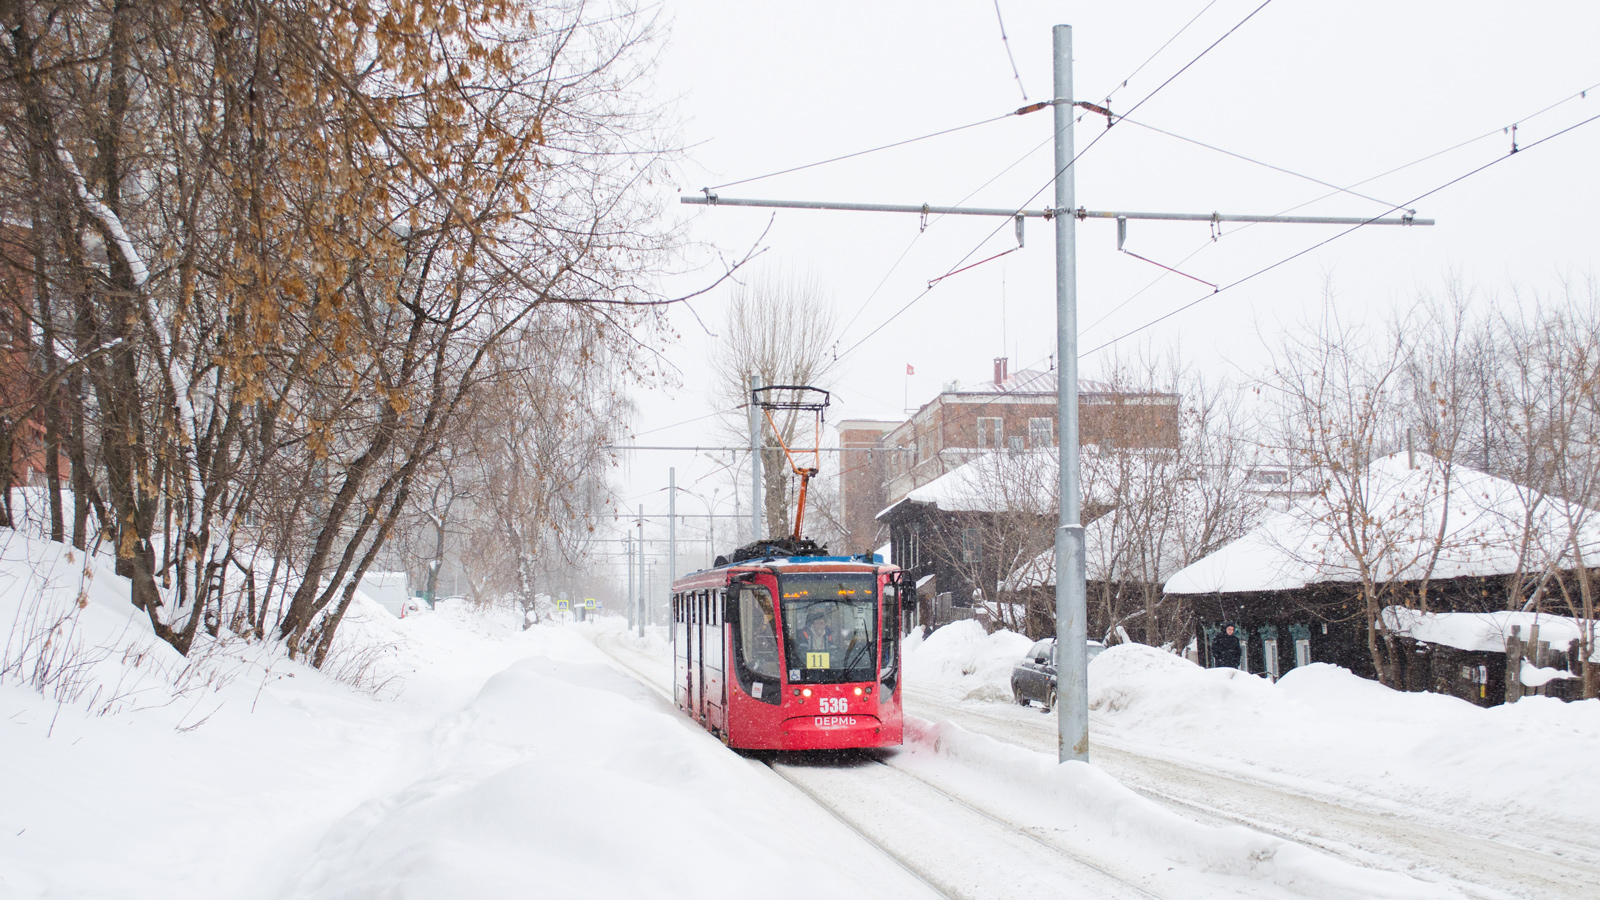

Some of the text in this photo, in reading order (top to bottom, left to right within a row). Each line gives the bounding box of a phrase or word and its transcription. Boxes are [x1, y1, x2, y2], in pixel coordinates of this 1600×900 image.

[811, 654, 824, 667] 11
[819, 698, 848, 713] 536
[814, 717, 856, 726] ПЕРМЬ
